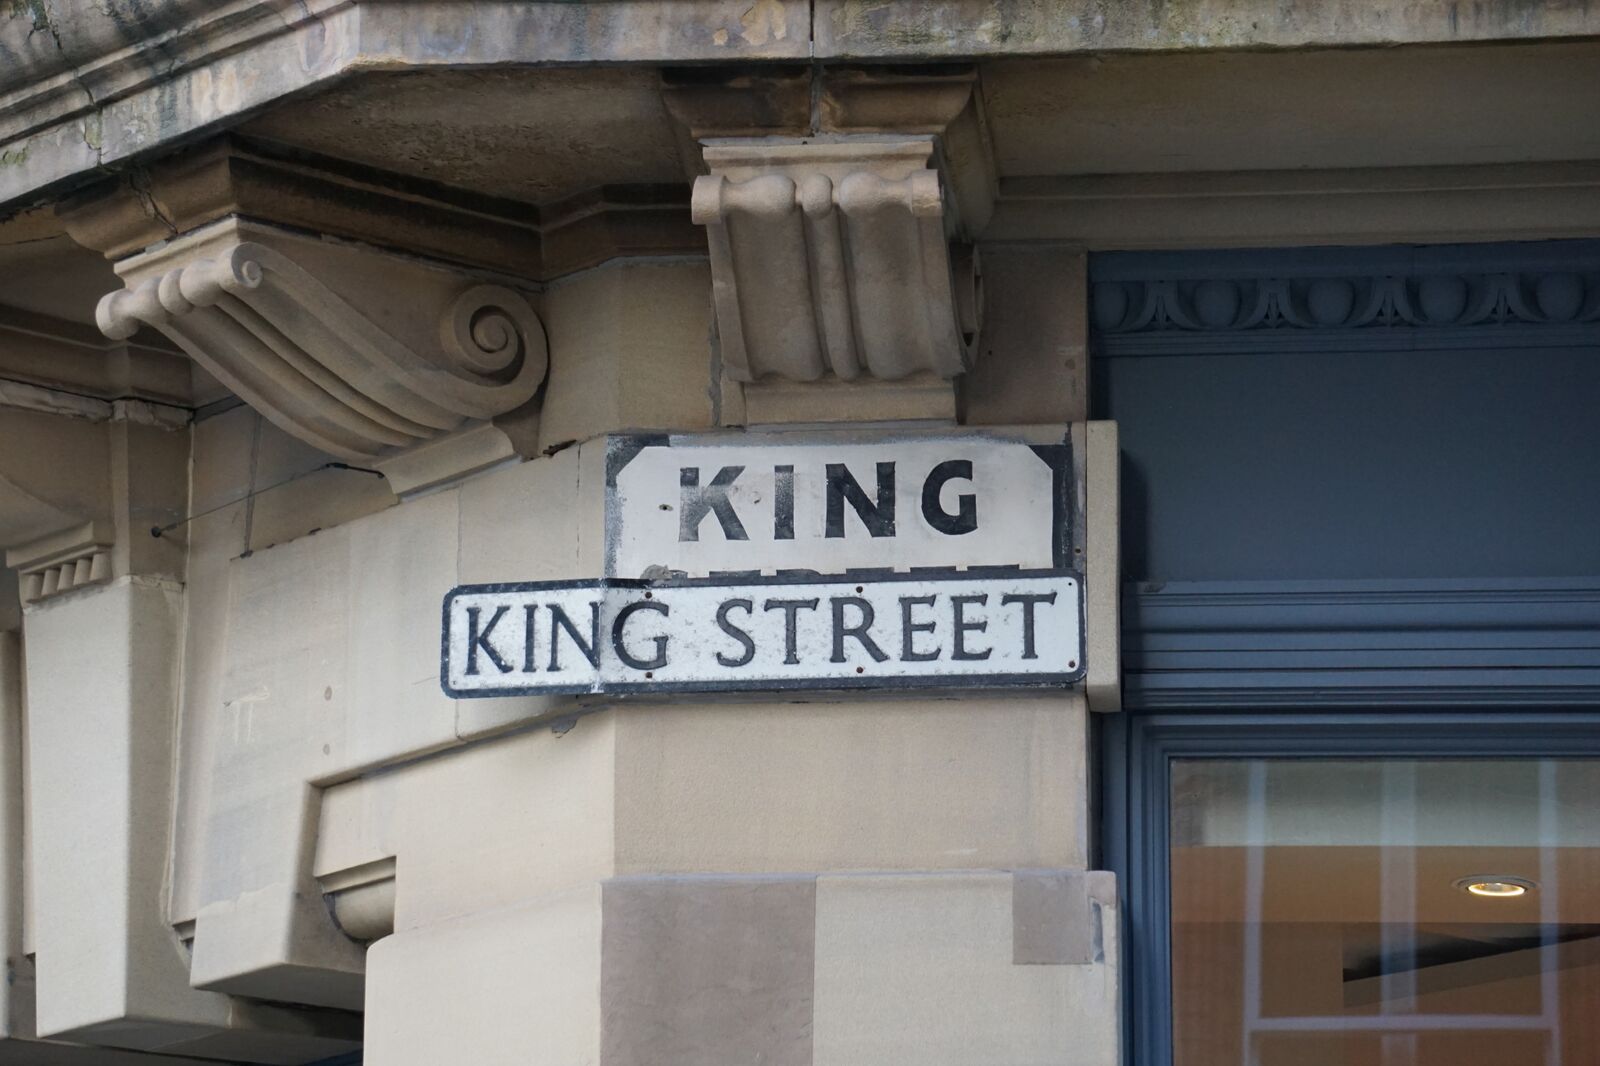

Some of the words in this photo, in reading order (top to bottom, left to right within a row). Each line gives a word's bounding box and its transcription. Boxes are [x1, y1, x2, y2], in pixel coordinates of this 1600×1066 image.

[680, 460, 978, 541] KING
[466, 601, 670, 675] KING
[716, 592, 1058, 667] STREET
